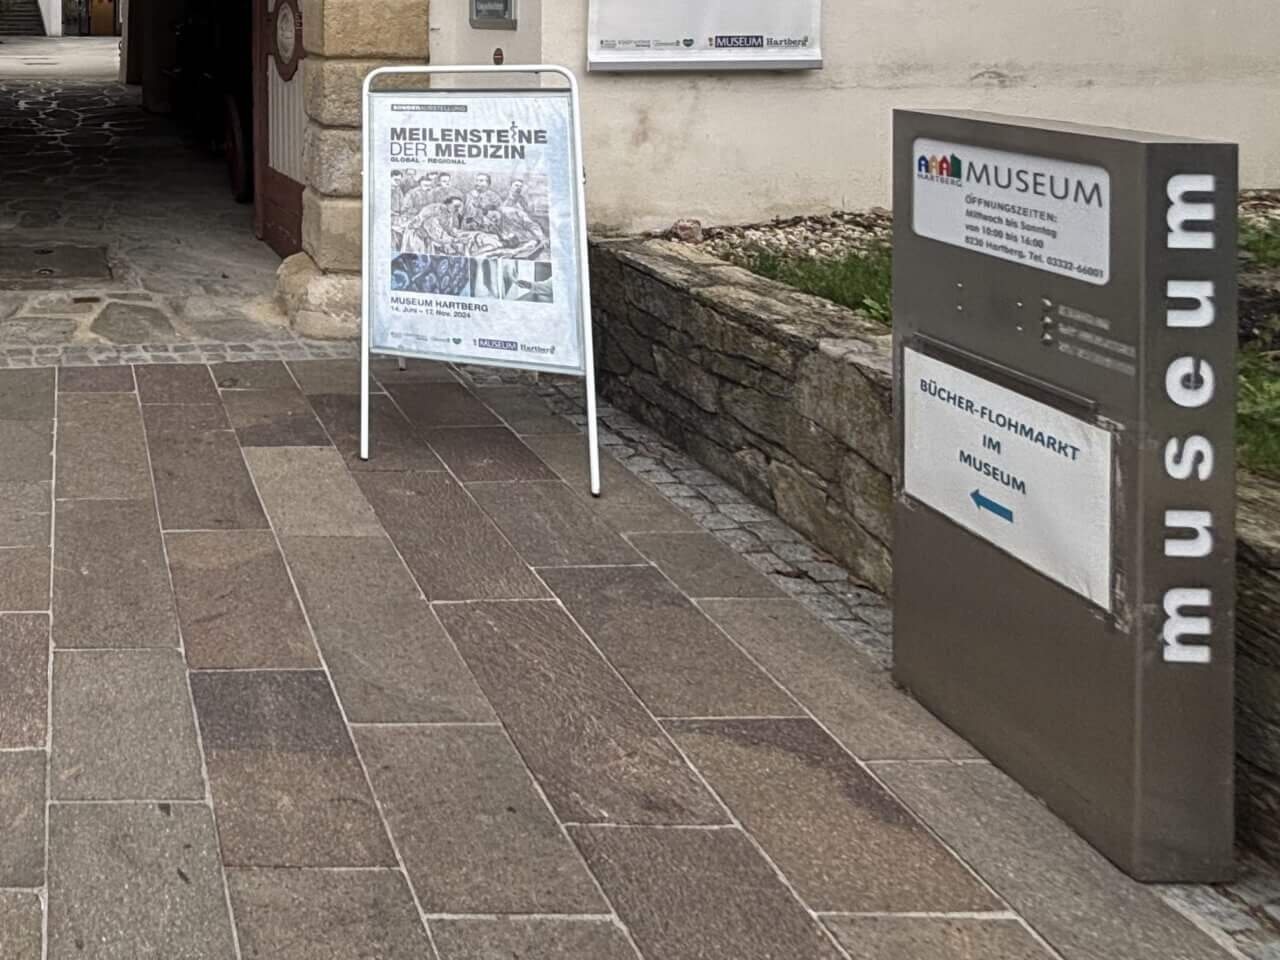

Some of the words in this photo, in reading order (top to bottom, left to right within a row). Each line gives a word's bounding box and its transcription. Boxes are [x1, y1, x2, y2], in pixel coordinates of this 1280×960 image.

[715, 37, 762, 47] MUSEUM
[390, 142, 428, 157] DER
[435, 143, 526, 160] MEDIZIN
[965, 161, 1103, 208] MUSEUM
[964, 192, 1057, 223] ÖFFNUNGSZEITEN:
[965, 209, 1003, 225] Mittwoch
[1005, 217, 1018, 228] bis
[1020, 220, 1057, 239] Sonntag
[965, 223, 980, 233] von
[1005, 232, 1018, 243] bis
[1029, 251, 1044, 264] Tel.
[390, 296, 433, 308] MUSEUM
[435, 301, 489, 313] HARTBERG
[919, 377, 1081, 462] BÜCHER-FLOHMARKT
[1162, 173, 1217, 664] museum
[981, 434, 1002, 455] IM
[958, 449, 1027, 495] MUSEUM
